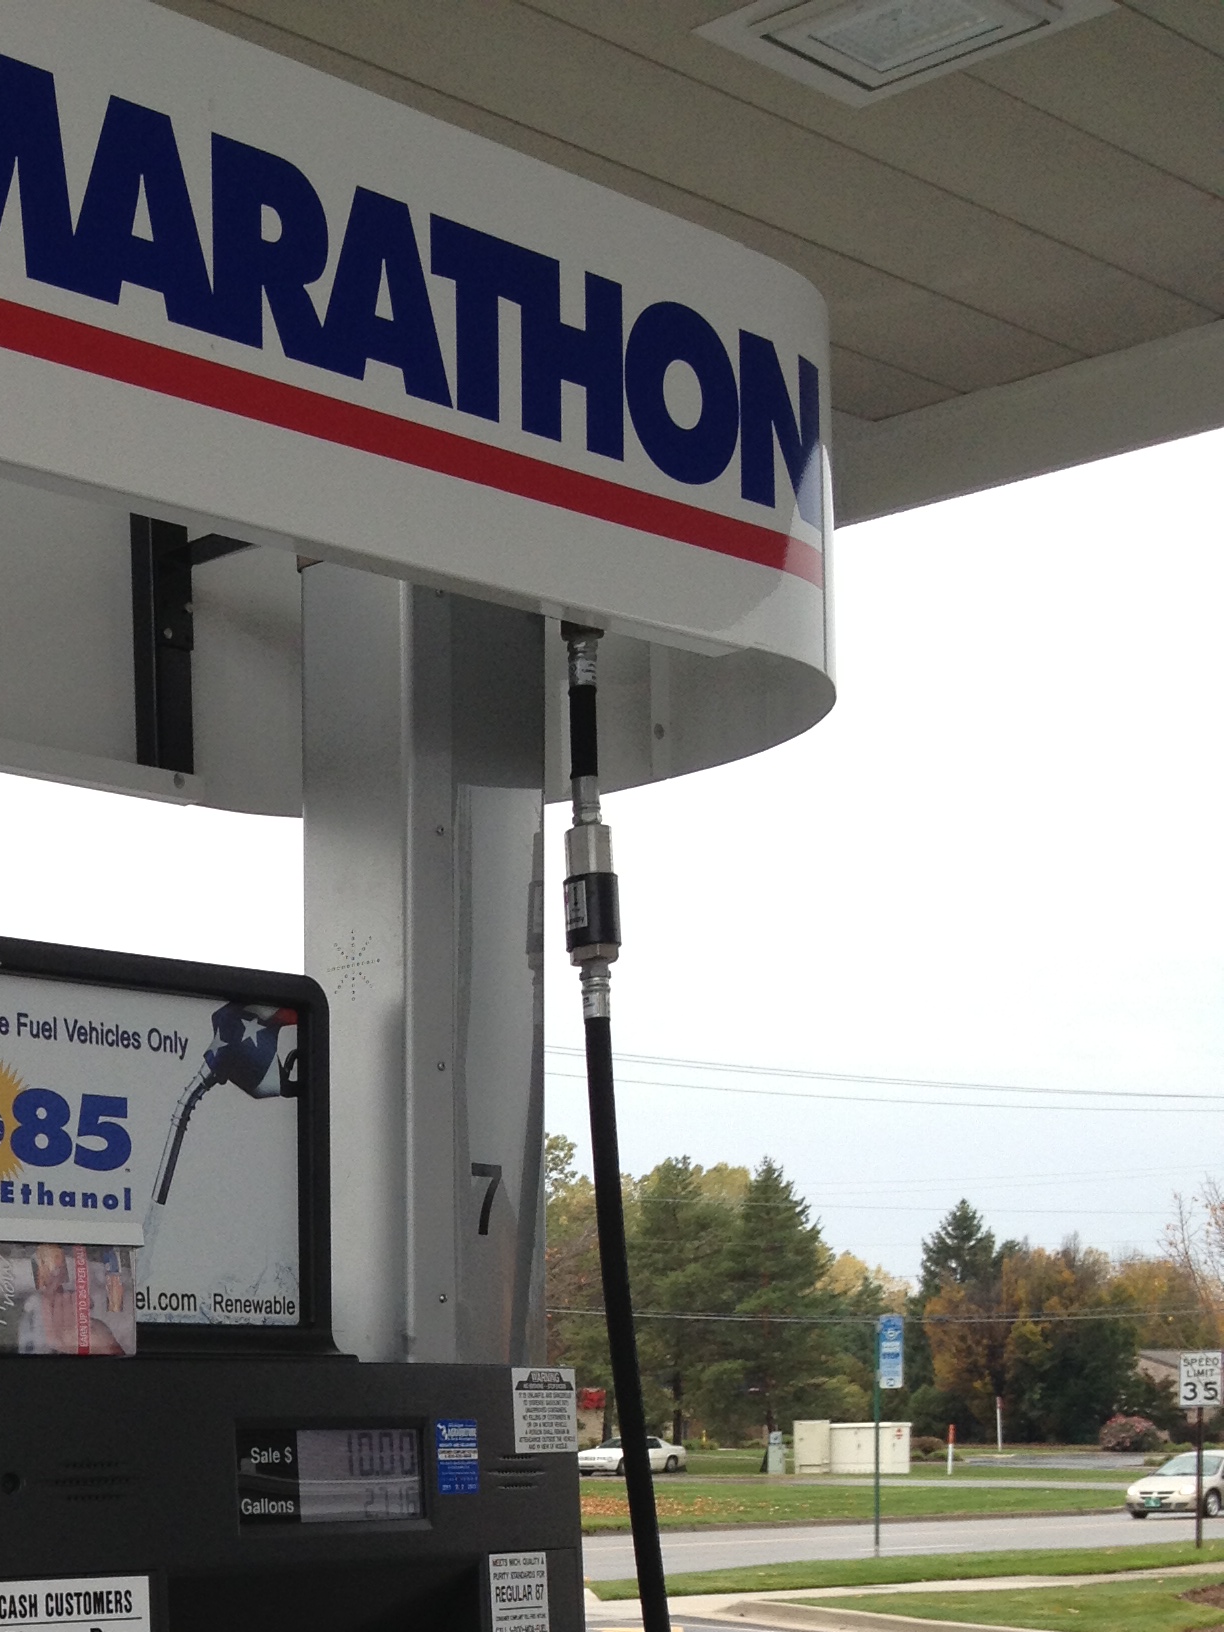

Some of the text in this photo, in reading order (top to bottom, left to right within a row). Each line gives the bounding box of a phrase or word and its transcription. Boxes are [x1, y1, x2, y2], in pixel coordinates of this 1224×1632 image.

[16, 1012, 58, 1041] Fuel
[64, 1019, 141, 1051] Vehicles
[147, 1029, 188, 1059] Only
[0, 1180, 132, 1211] Ethanol
[471, 1163, 502, 1235] 7
[78, 1298, 89, 1312] TO
[213, 1284, 296, 1316] Renewable
[79, 1312, 89, 1327] UP
[1182, 1357, 1219, 1367] SPEED
[1186, 1367, 1216, 1378] LIMIT
[1182, 1381, 1219, 1401] 35
[250, 1446, 293, 1465] Sale $
[241, 1498, 294, 1515] Gallons
[495, 1583, 544, 1603] REGULAR 87
[45, 1589, 133, 1618] CUSTOMERS
